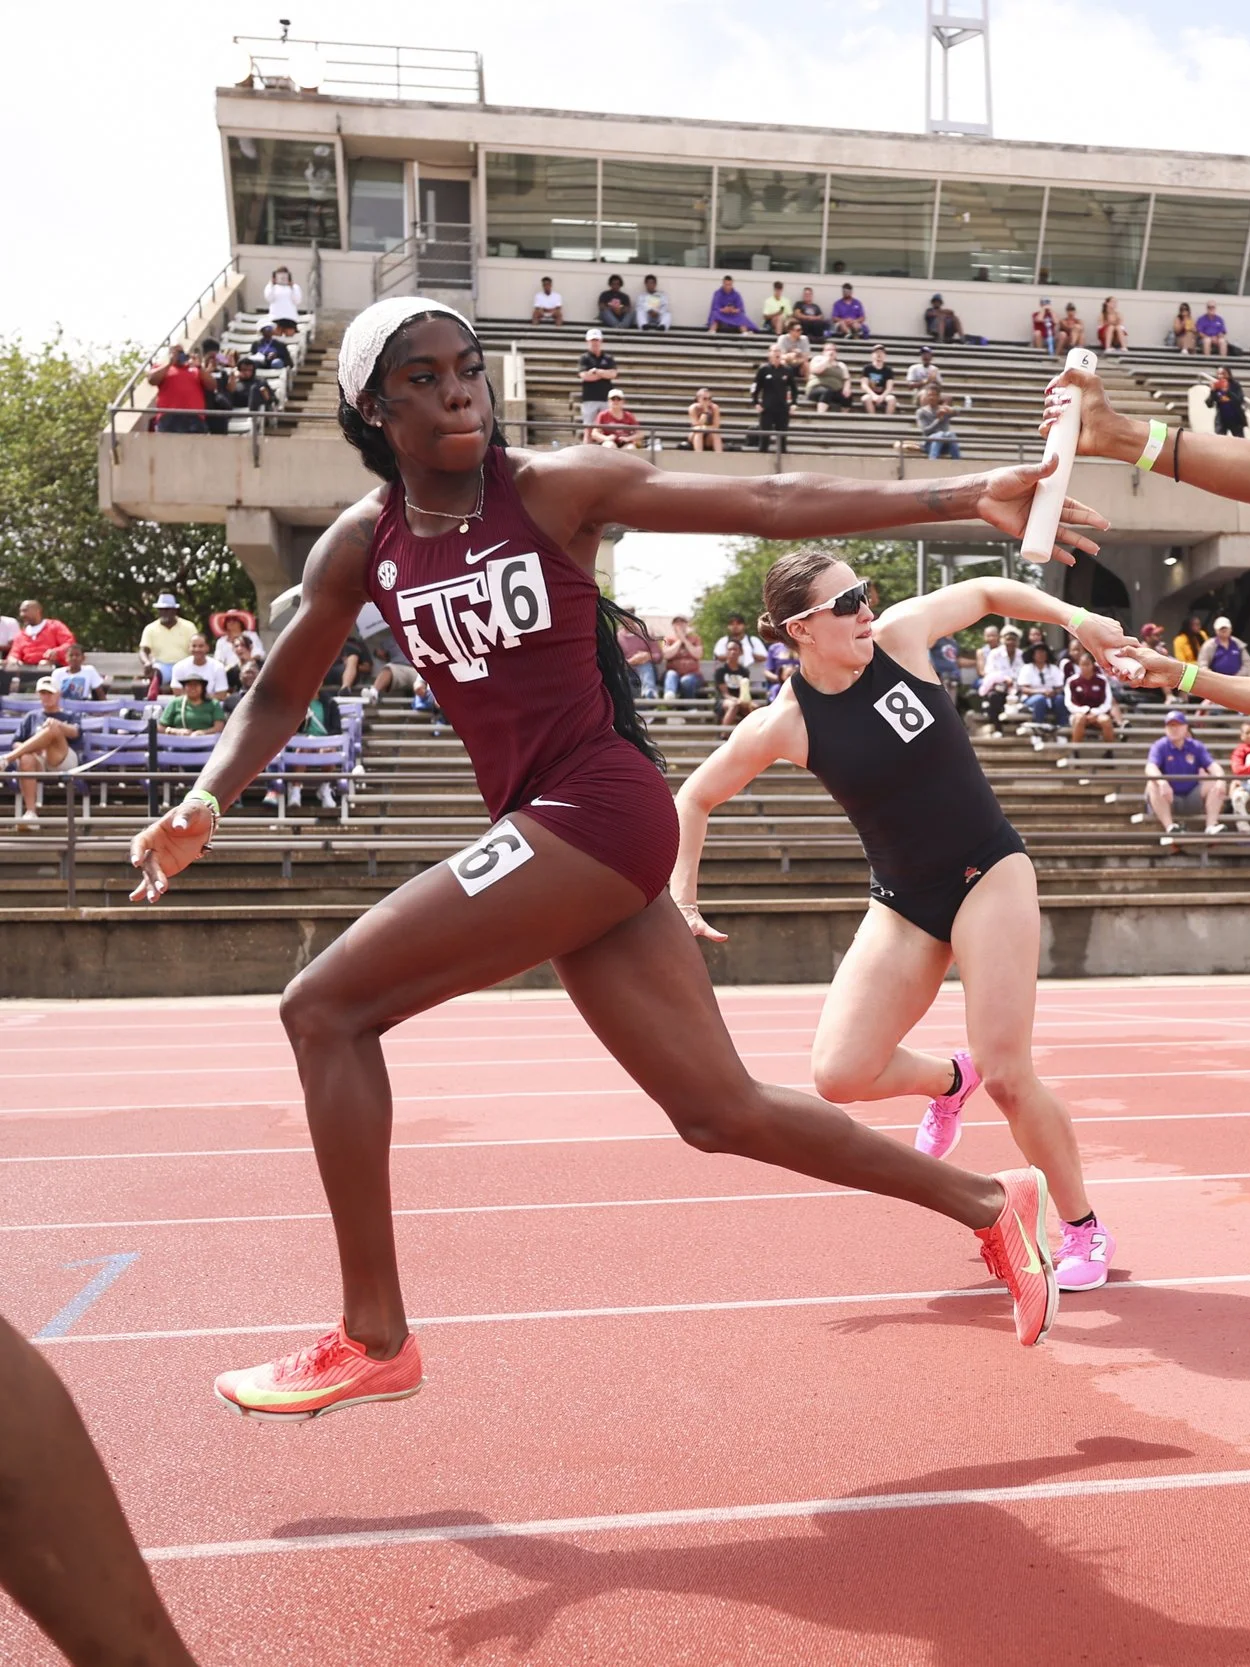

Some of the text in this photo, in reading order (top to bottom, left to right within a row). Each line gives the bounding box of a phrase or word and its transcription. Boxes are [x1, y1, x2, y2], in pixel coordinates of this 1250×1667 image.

[378, 561, 397, 589] SEC
[501, 561, 539, 630] 6
[885, 692, 924, 732] 8
[458, 834, 521, 880] 6
